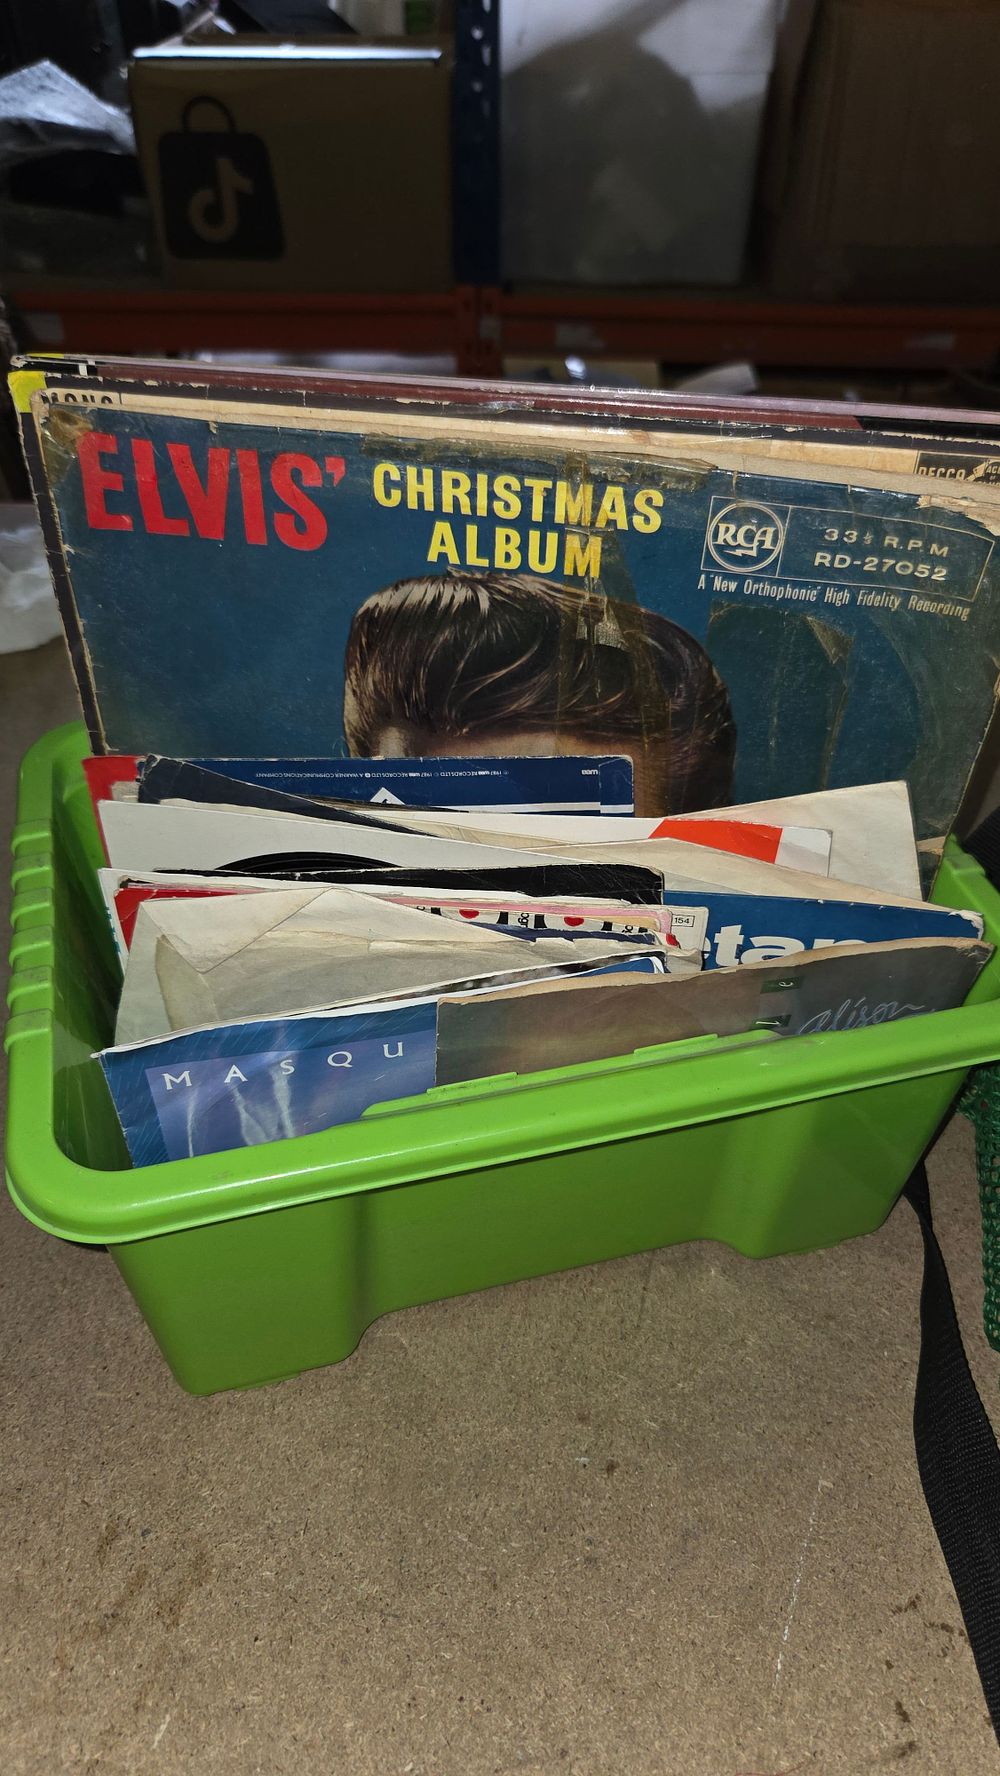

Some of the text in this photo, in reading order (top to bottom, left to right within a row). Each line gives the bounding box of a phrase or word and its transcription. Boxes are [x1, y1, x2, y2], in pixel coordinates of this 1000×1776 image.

[372, 462, 665, 534] CHRISTMAS
[426, 520, 603, 579] ALBUM
[713, 523, 777, 552] RCA
[814, 551, 948, 582] RD-27052
[697, 574, 706, 590] A
[824, 586, 851, 607] High
[856, 589, 902, 612] Fidelity
[907, 594, 971, 622] Recording
